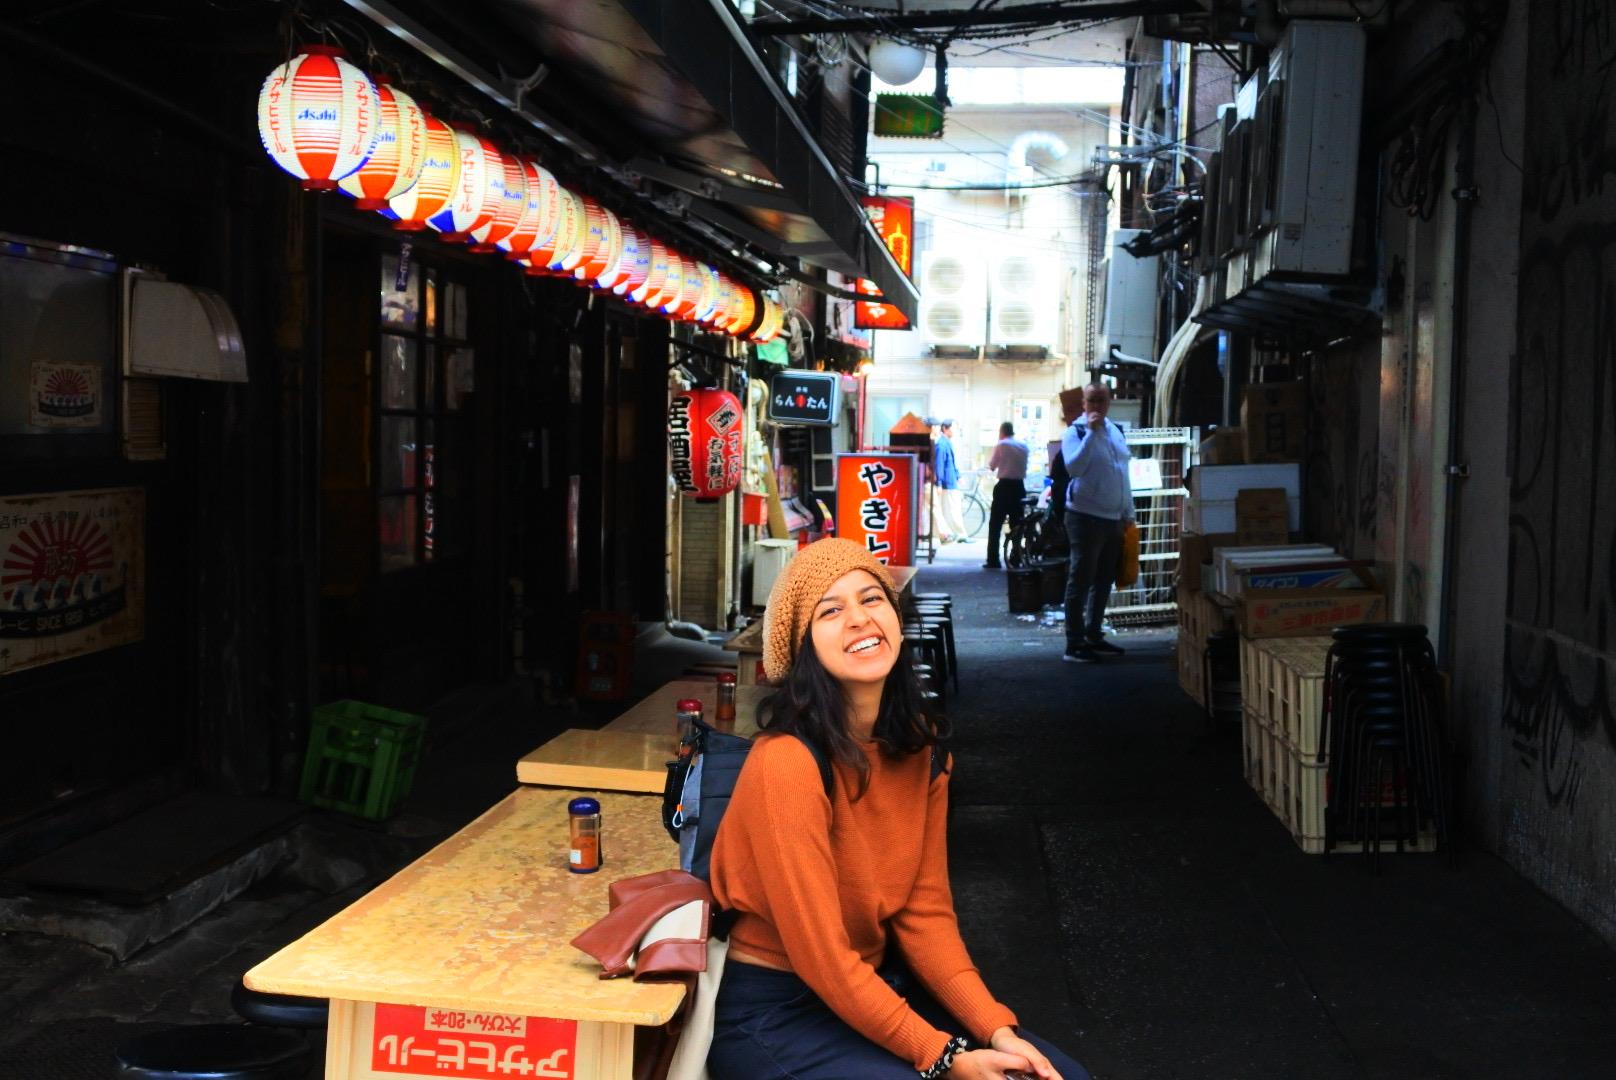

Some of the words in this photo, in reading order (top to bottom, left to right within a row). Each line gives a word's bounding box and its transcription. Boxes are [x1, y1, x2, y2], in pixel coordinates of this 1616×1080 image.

[267, 76, 288, 153] アサヒビール
[297, 107, 337, 121] Asahi
[348, 80, 369, 156] アサヒビール
[405, 105, 421, 179] アサヒビール
[423, 157, 451, 169] Asahi
[459, 148, 476, 213] アサヒビール
[707, 437, 726, 490] お気軽に
[430, 1010, 522, 1034] 大びん・20本
[378, 1034, 569, 1079] アサヒビール
